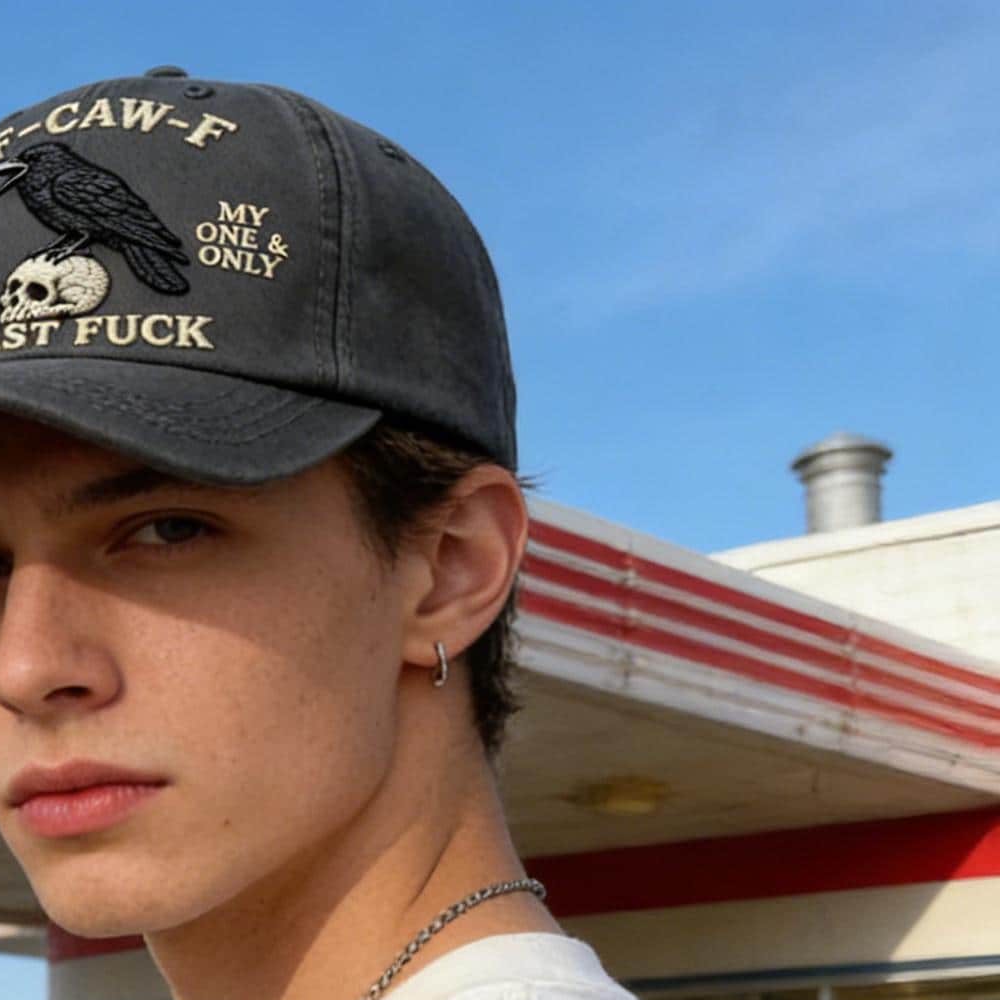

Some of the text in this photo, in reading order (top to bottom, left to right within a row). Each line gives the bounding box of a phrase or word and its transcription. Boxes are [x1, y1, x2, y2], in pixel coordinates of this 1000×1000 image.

[217, 200, 270, 228] MY
[195, 221, 289, 258] ONE &
[198, 246, 283, 279] ONLY
[73, 314, 215, 351] FUCK
